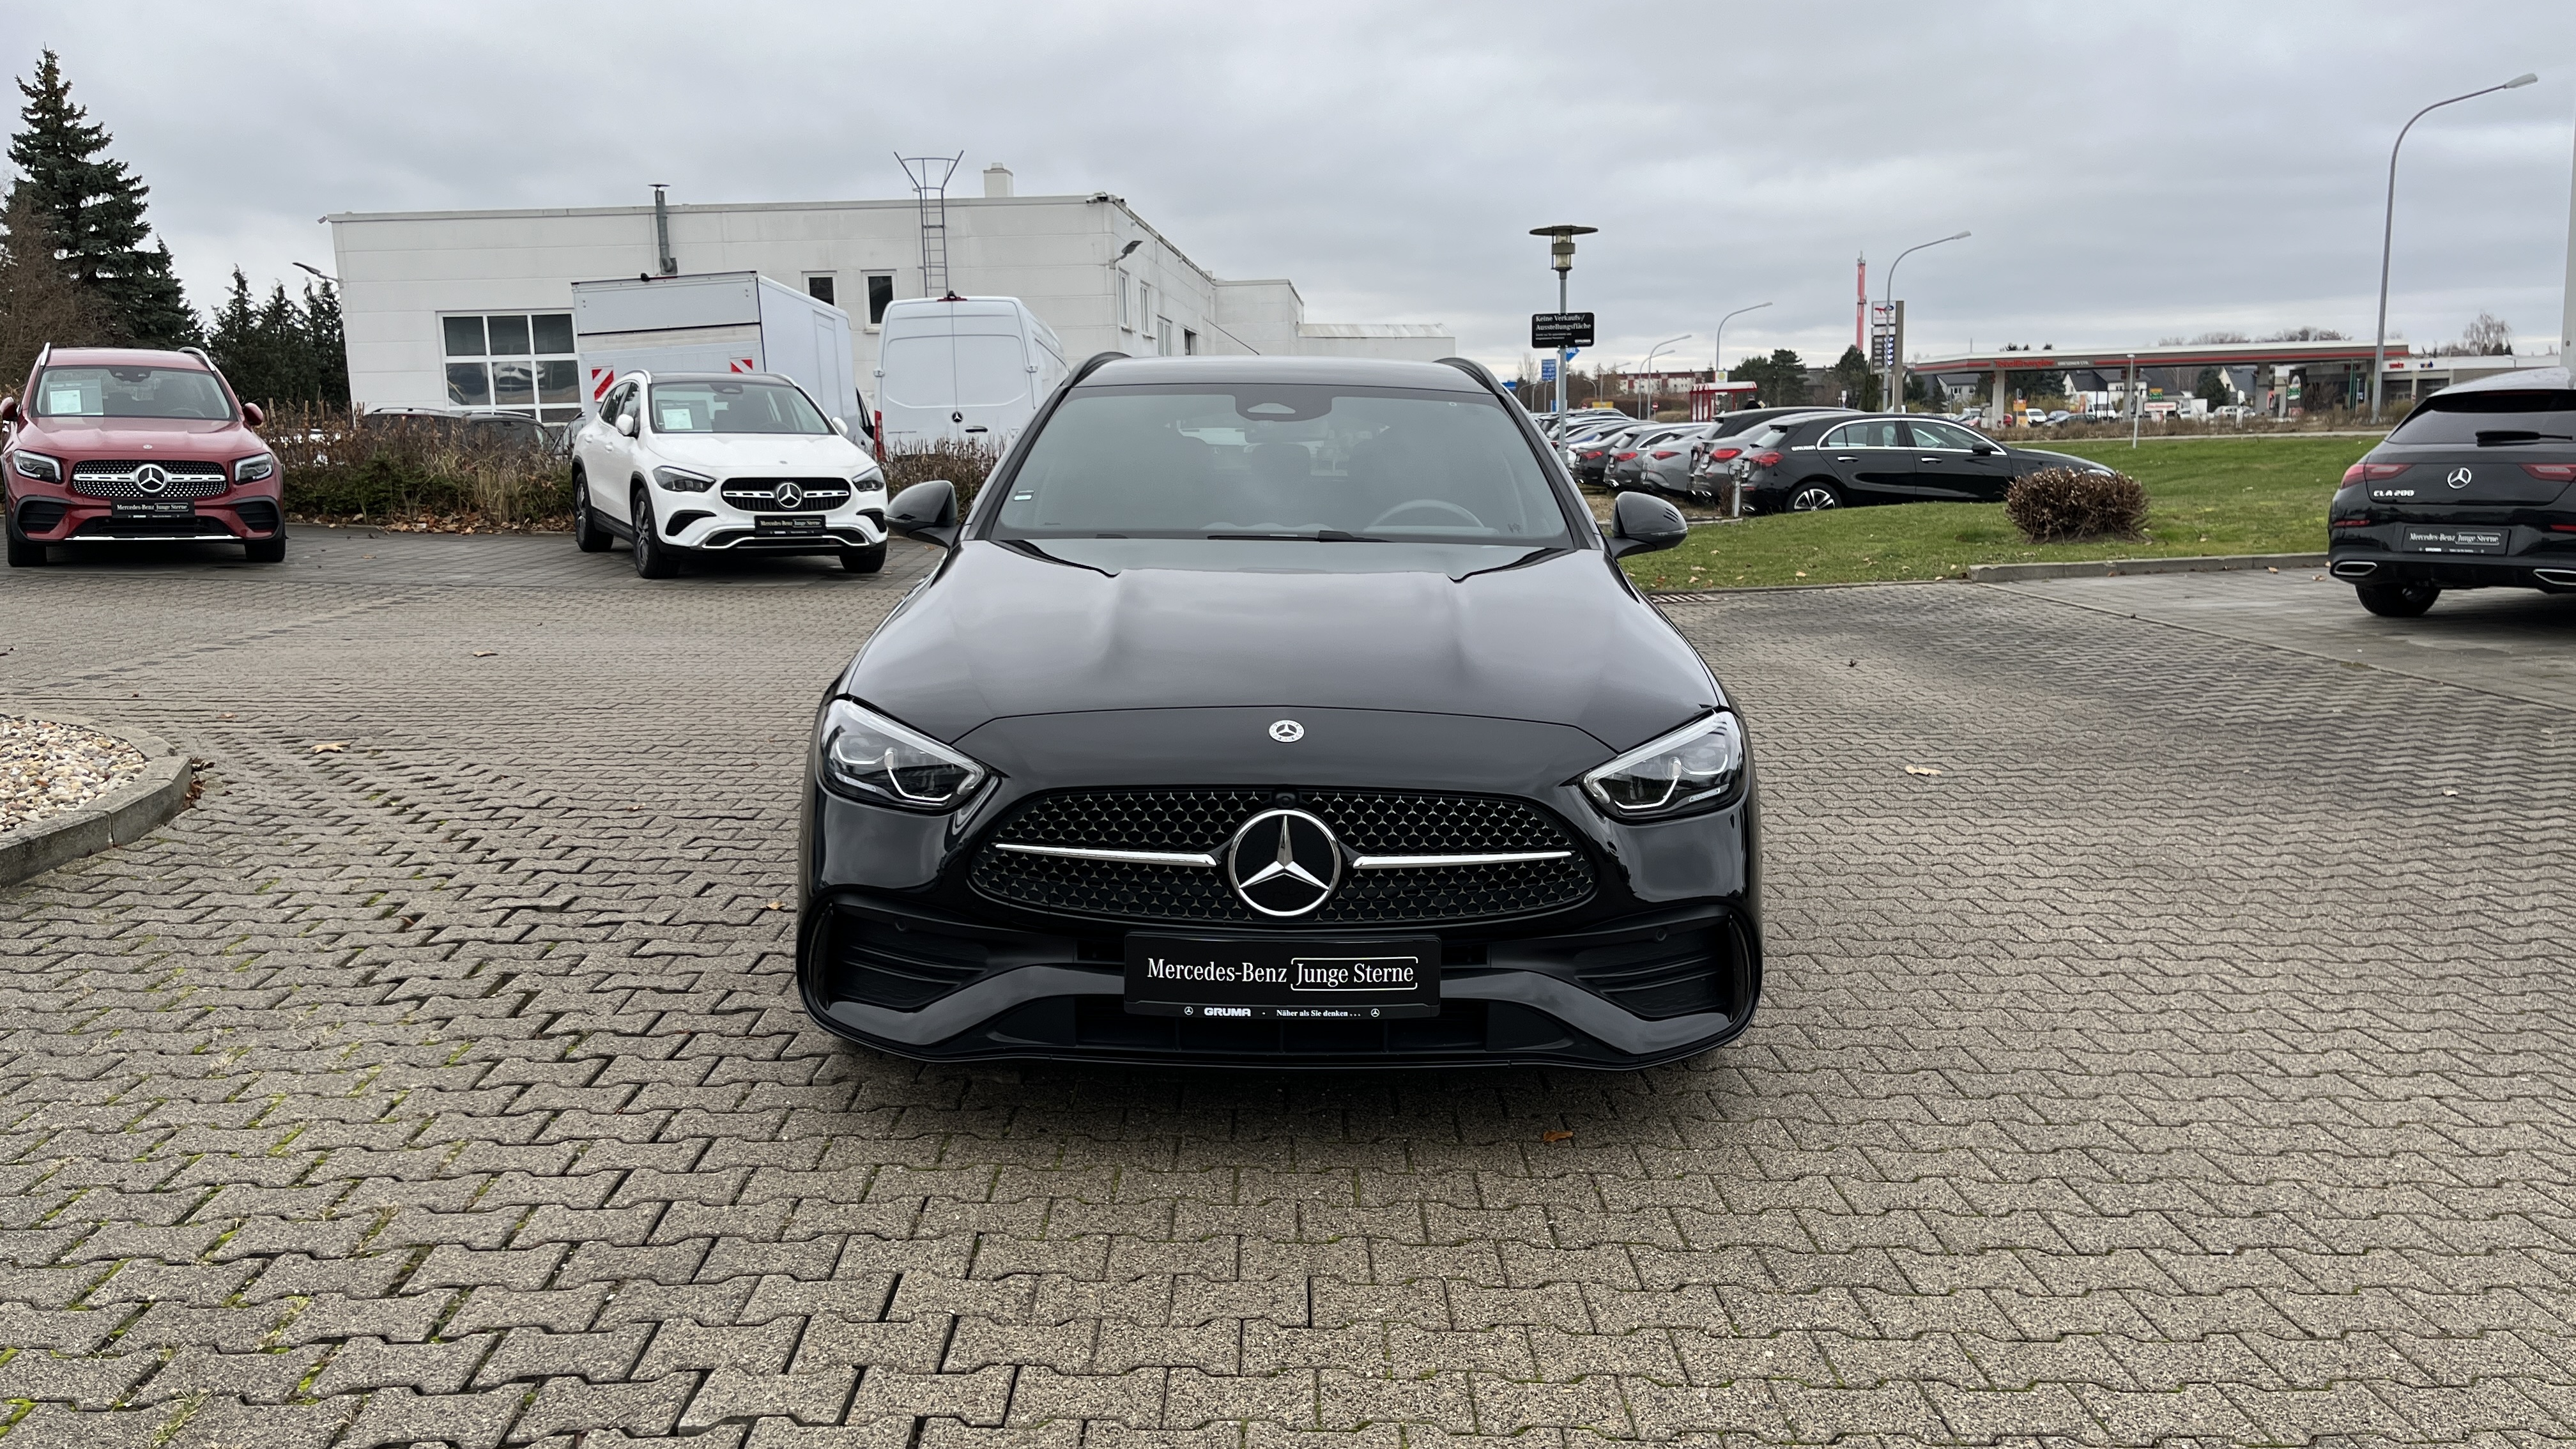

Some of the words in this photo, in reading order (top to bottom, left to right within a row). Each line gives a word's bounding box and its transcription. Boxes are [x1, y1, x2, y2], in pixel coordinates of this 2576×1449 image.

[1535, 323, 1591, 331] Ausstellungsfläche
[1147, 957, 1287, 983] Mercedes-Benz
[1296, 963, 1349, 988] Junge
[1353, 963, 1414, 983] Sterne
[1204, 1007, 1252, 1017] GRUMA
